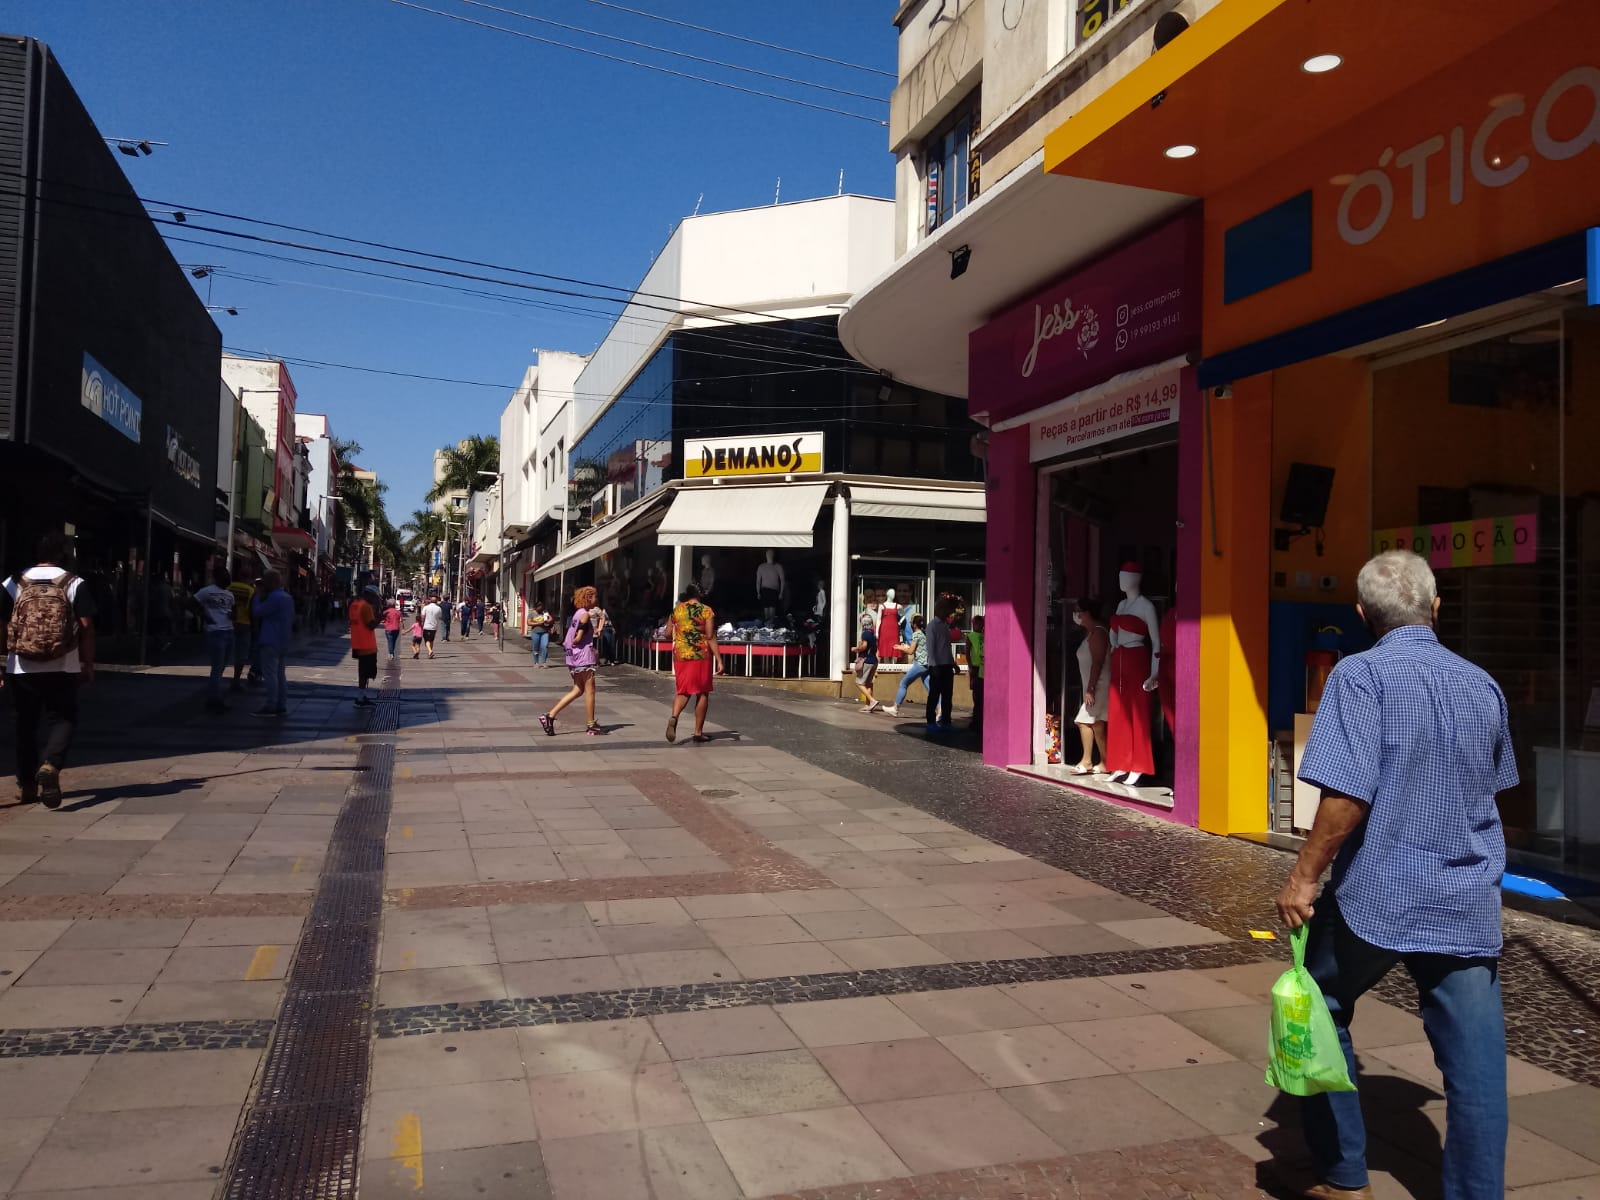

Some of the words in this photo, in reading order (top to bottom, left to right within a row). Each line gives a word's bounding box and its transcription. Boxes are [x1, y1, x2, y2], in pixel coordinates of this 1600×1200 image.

[103, 383, 120, 417] HOT
[119, 399, 141, 434] POINT
[1040, 423, 1069, 441] Peças
[1070, 419, 1077, 431] a
[1078, 408, 1108, 432] partir
[1109, 402, 1123, 418] de
[1126, 393, 1142, 414] R$
[1144, 383, 1178, 407] 14,99
[1066, 427, 1106, 446] Parcelamos
[1106, 423, 1119, 434] em
[701, 436, 804, 475] DEMANOS
[1380, 525, 1529, 556] PROMOÇÃO
